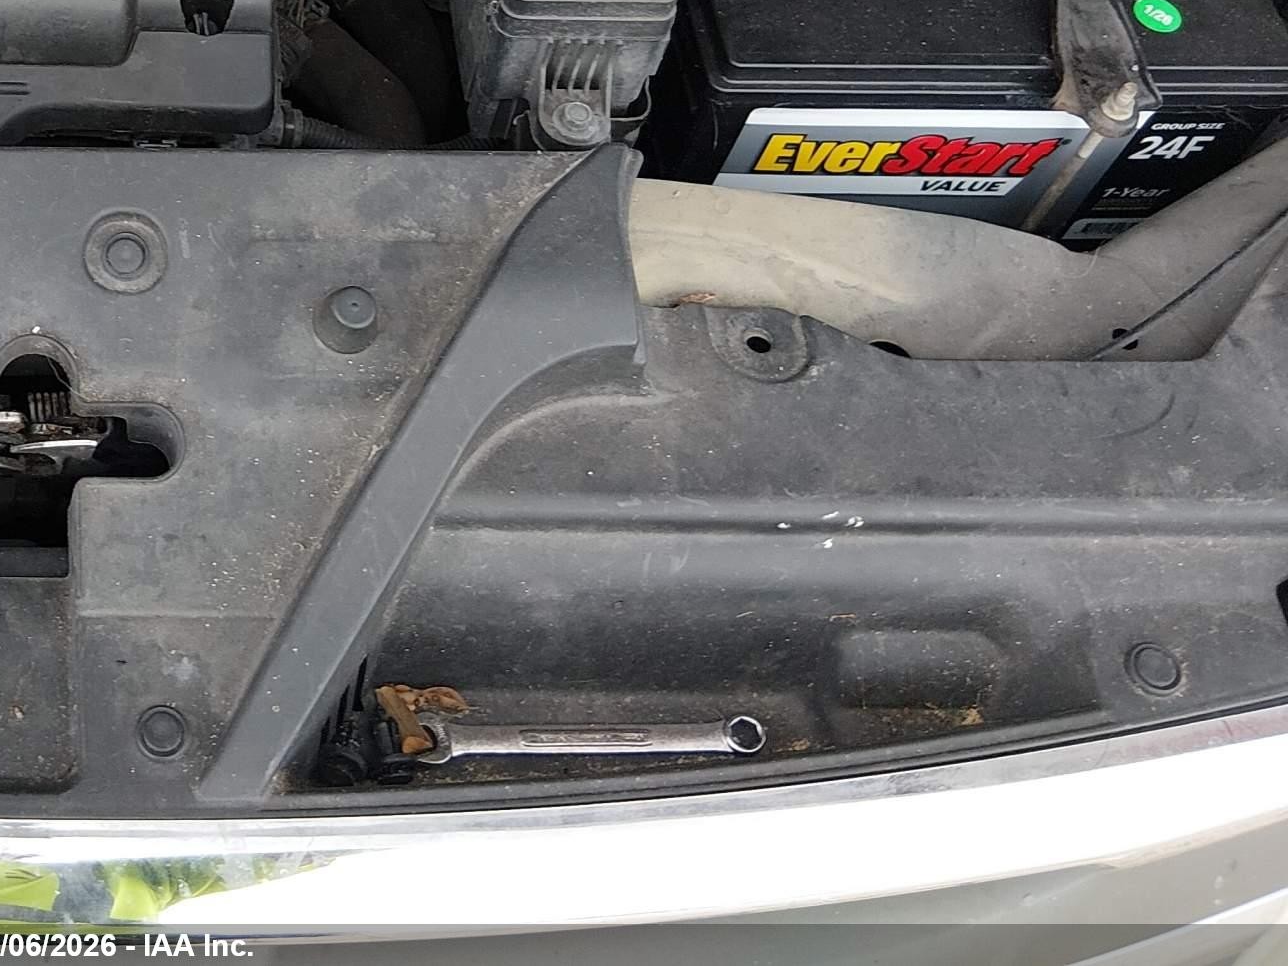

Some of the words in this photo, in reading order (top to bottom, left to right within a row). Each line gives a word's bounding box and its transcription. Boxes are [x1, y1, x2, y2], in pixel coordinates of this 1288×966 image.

[1151, 122, 1197, 131] GROUP
[1197, 122, 1226, 130] SIZE
[1127, 135, 1215, 160] 24F
[753, 132, 1063, 177] EverStart
[920, 180, 1006, 193] VALUE
[1101, 186, 1171, 199] 1-Year
